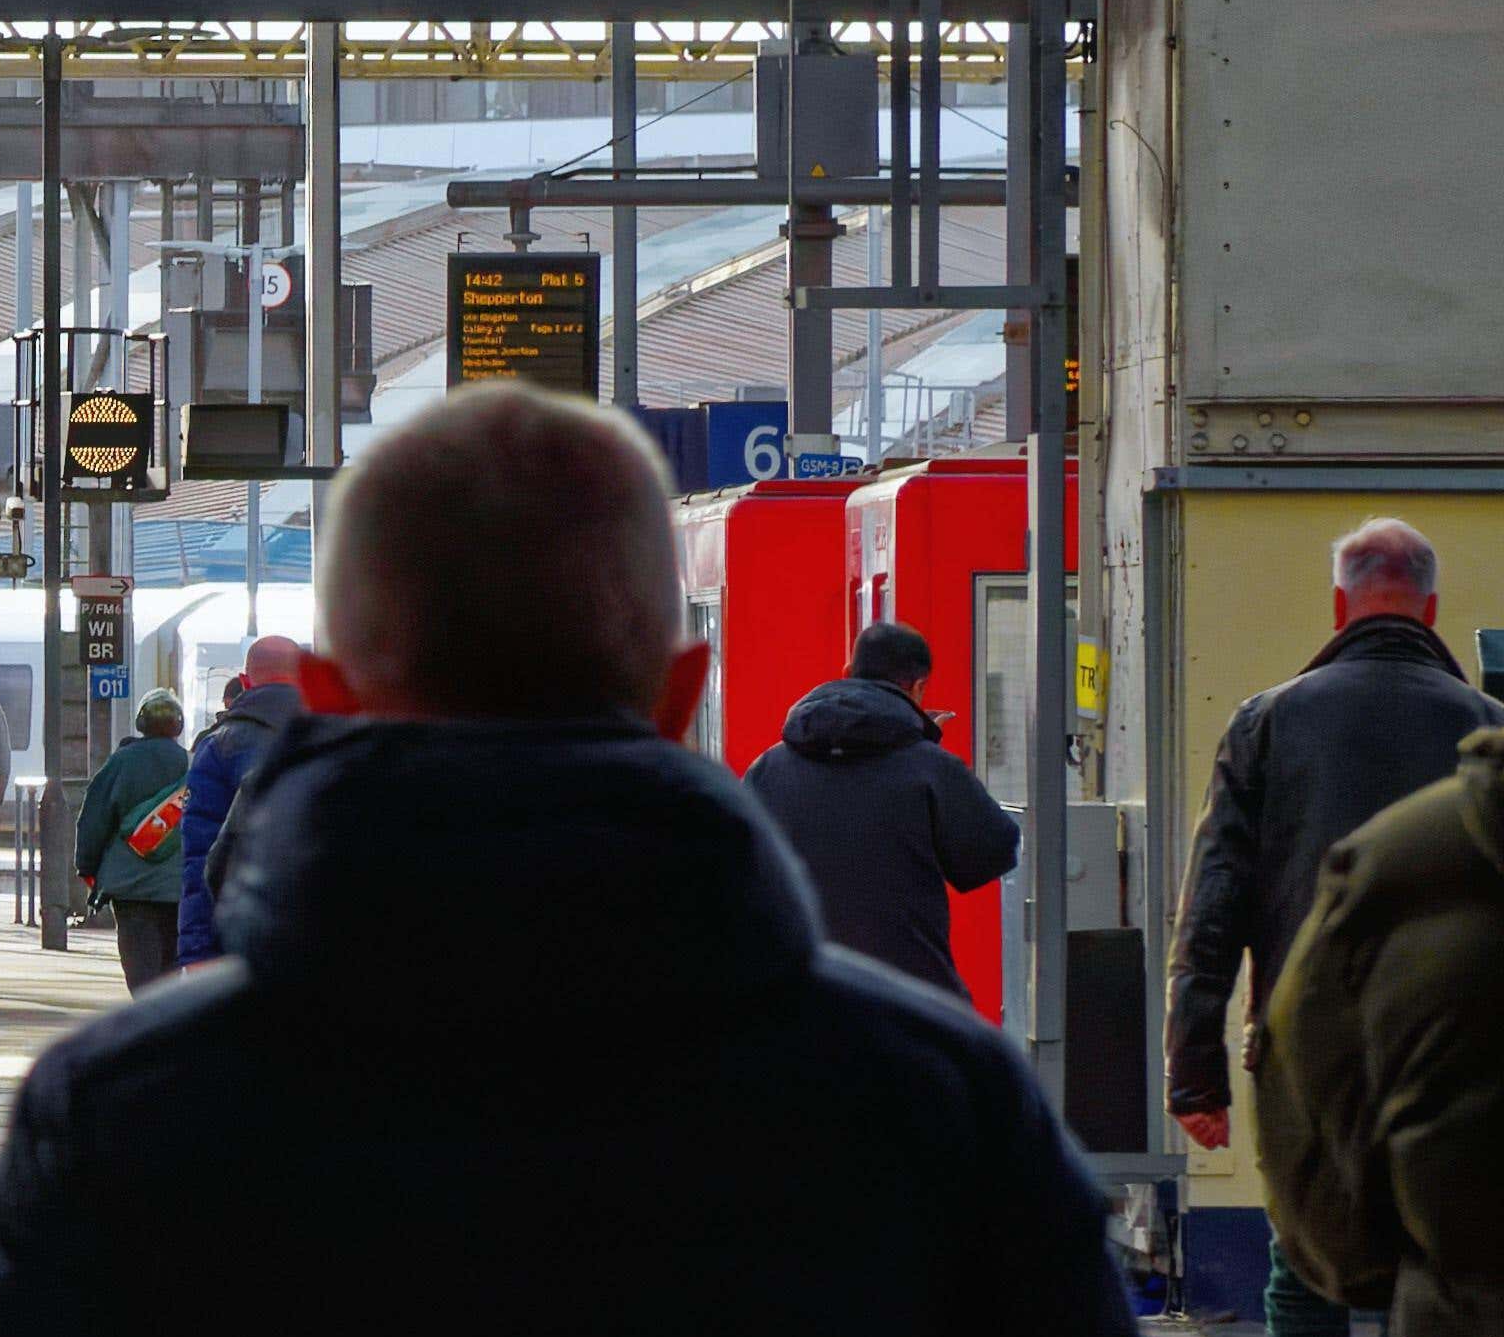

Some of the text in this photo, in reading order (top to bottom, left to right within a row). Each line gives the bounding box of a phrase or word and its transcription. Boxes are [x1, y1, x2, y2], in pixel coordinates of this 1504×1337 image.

[542, 273, 568, 287] Plat
[463, 291, 544, 305] Shepperton
[744, 425, 781, 481] 6
[88, 643, 114, 659] BR
[98, 678, 124, 698] 011
